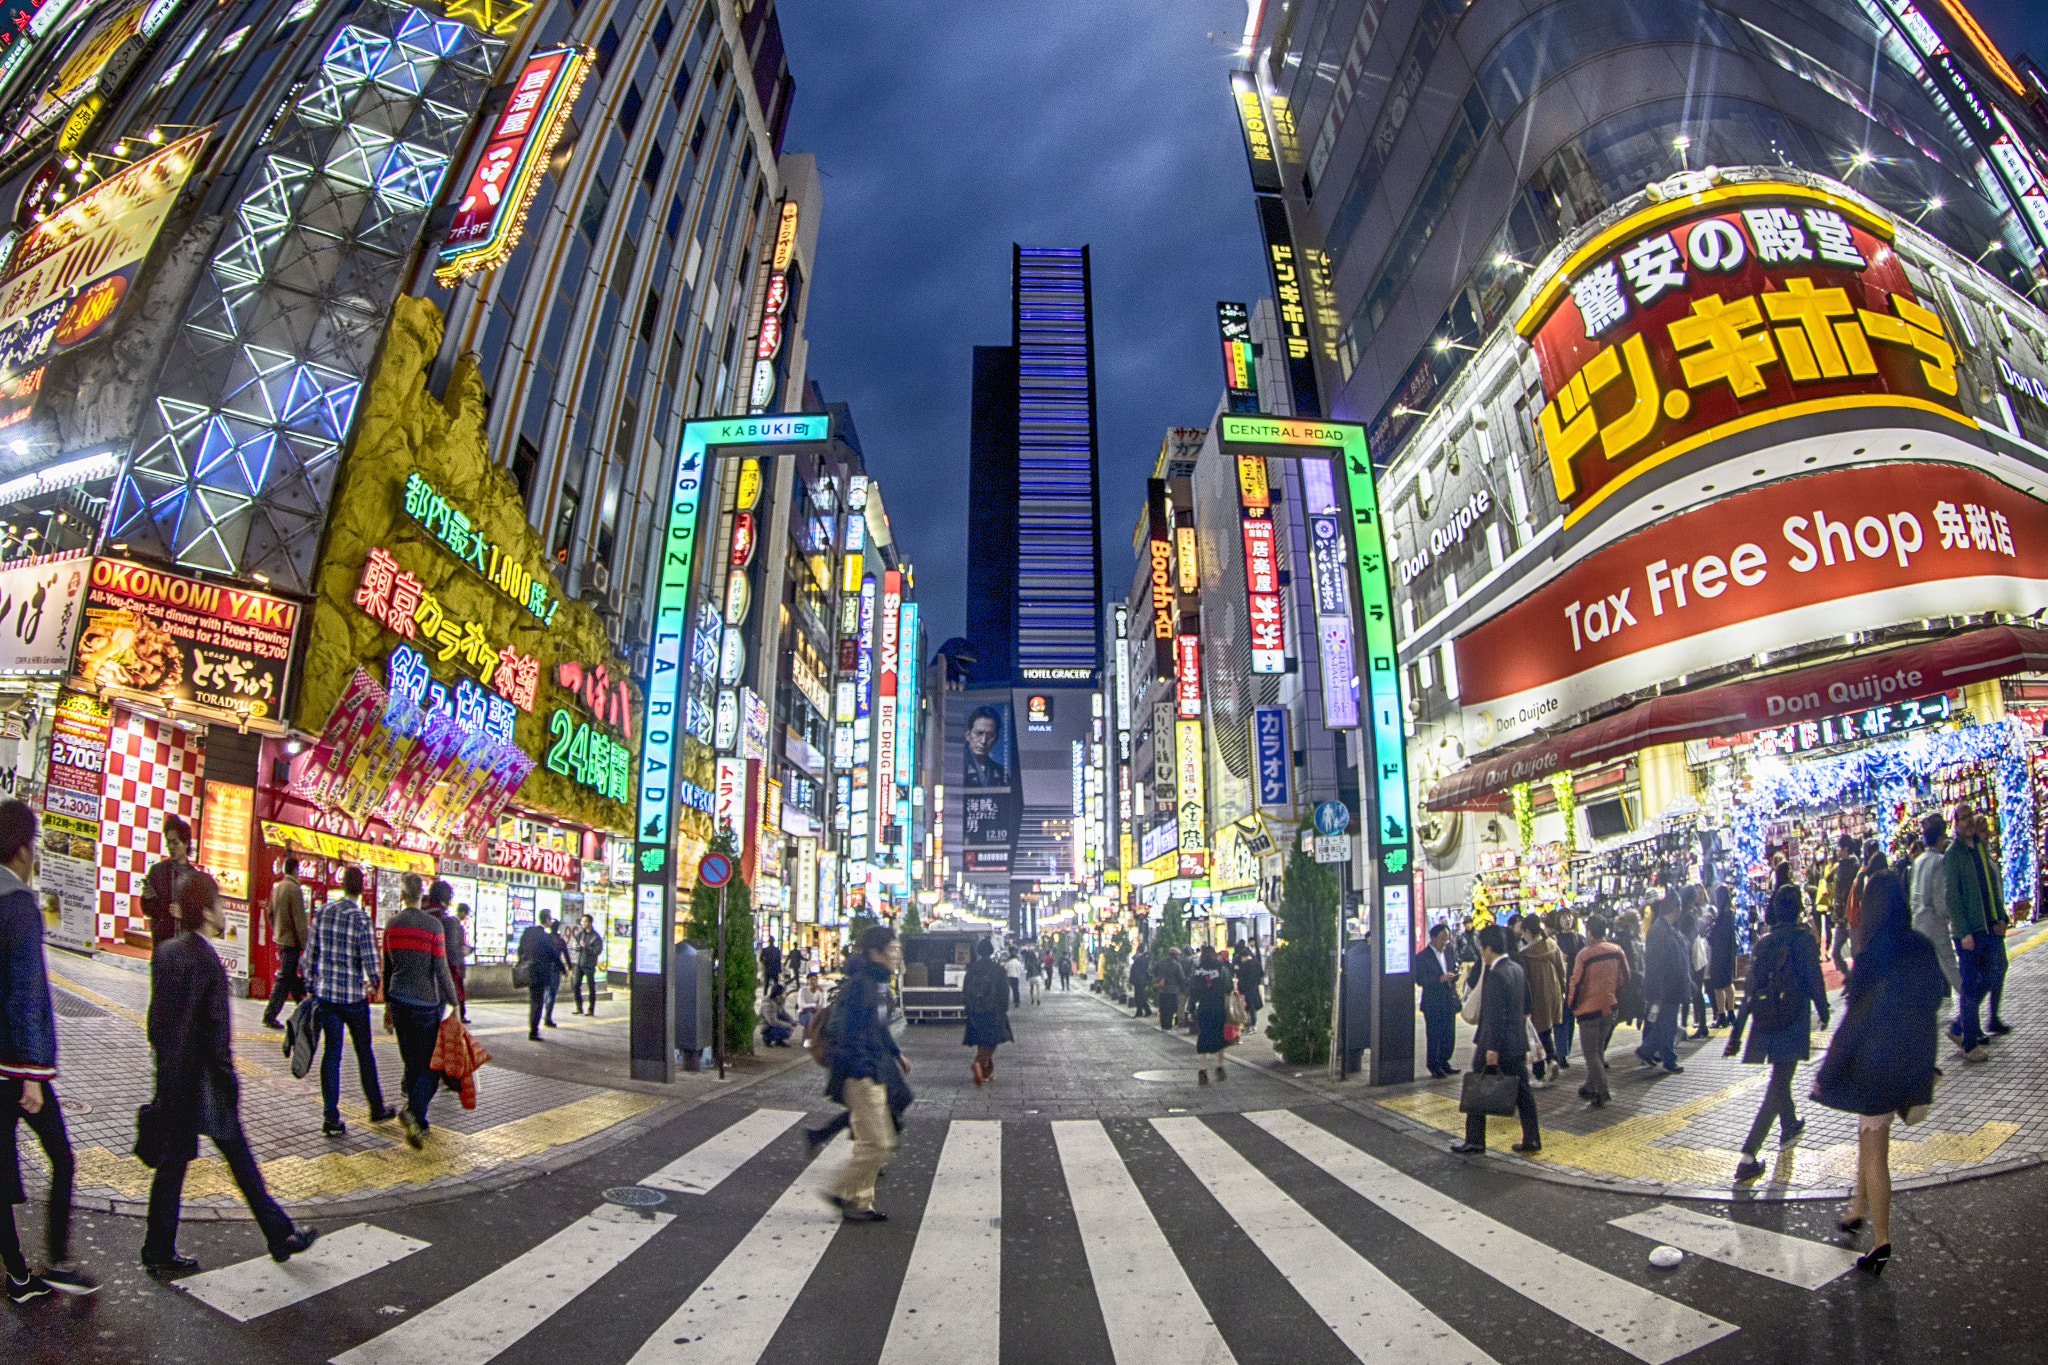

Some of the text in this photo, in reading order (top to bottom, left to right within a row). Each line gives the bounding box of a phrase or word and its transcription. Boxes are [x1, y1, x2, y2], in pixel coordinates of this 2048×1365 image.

[498, 68, 551, 136] 居酒屋
[1241, 91, 1272, 161] 驚安の殿堂
[1571, 207, 1868, 339] 驚安の殿堂
[1230, 424, 1344, 441] CENTRAL ROAD
[1248, 507, 1265, 518] 6F
[1401, 548, 1429, 586] Don
[1430, 488, 1491, 560] Quijote
[1564, 500, 2018, 652] Tax Free Shop 免税店
[92, 561, 296, 631] OKONOMI YAKI
[88, 590, 291, 647] All-You-Can-Eat dinner with Free-Flowing
[355, 547, 540, 714] 東京カラオケ本舗
[881, 592, 901, 674] SHIDAX
[162, 620, 288, 660] Drinks for 2 hours ¥2,700
[644, 478, 698, 802] GODZILLA ROAD
[1355, 507, 1398, 780] ゴジラロード
[1023, 669, 1092, 679] HOTEL GRACERY
[1766, 669, 1924, 717] Don Quijote
[251, 702, 267, 714] 2F
[1334, 701, 1348, 713] 5F
[1496, 696, 1559, 733] Don Quijote
[880, 704, 893, 769] BIC DRUG
[1028, 724, 1053, 733] IMAX
[171, 748, 182, 761] 2F
[547, 708, 630, 804] 24時間
[1261, 713, 1284, 801] カラオケ
[1485, 751, 1558, 787] Don Quijote
[139, 789, 150, 801] 2F
[1158, 803, 1174, 811] B1
[105, 826, 117, 839] 2F
[966, 819, 979, 833] 男
[985, 829, 1008, 840] 12.10
[1181, 801, 1204, 850] 金の蔵
[496, 840, 572, 878] カラオケBOX
[133, 877, 143, 890] 2F
[103, 918, 114, 931] 2F
